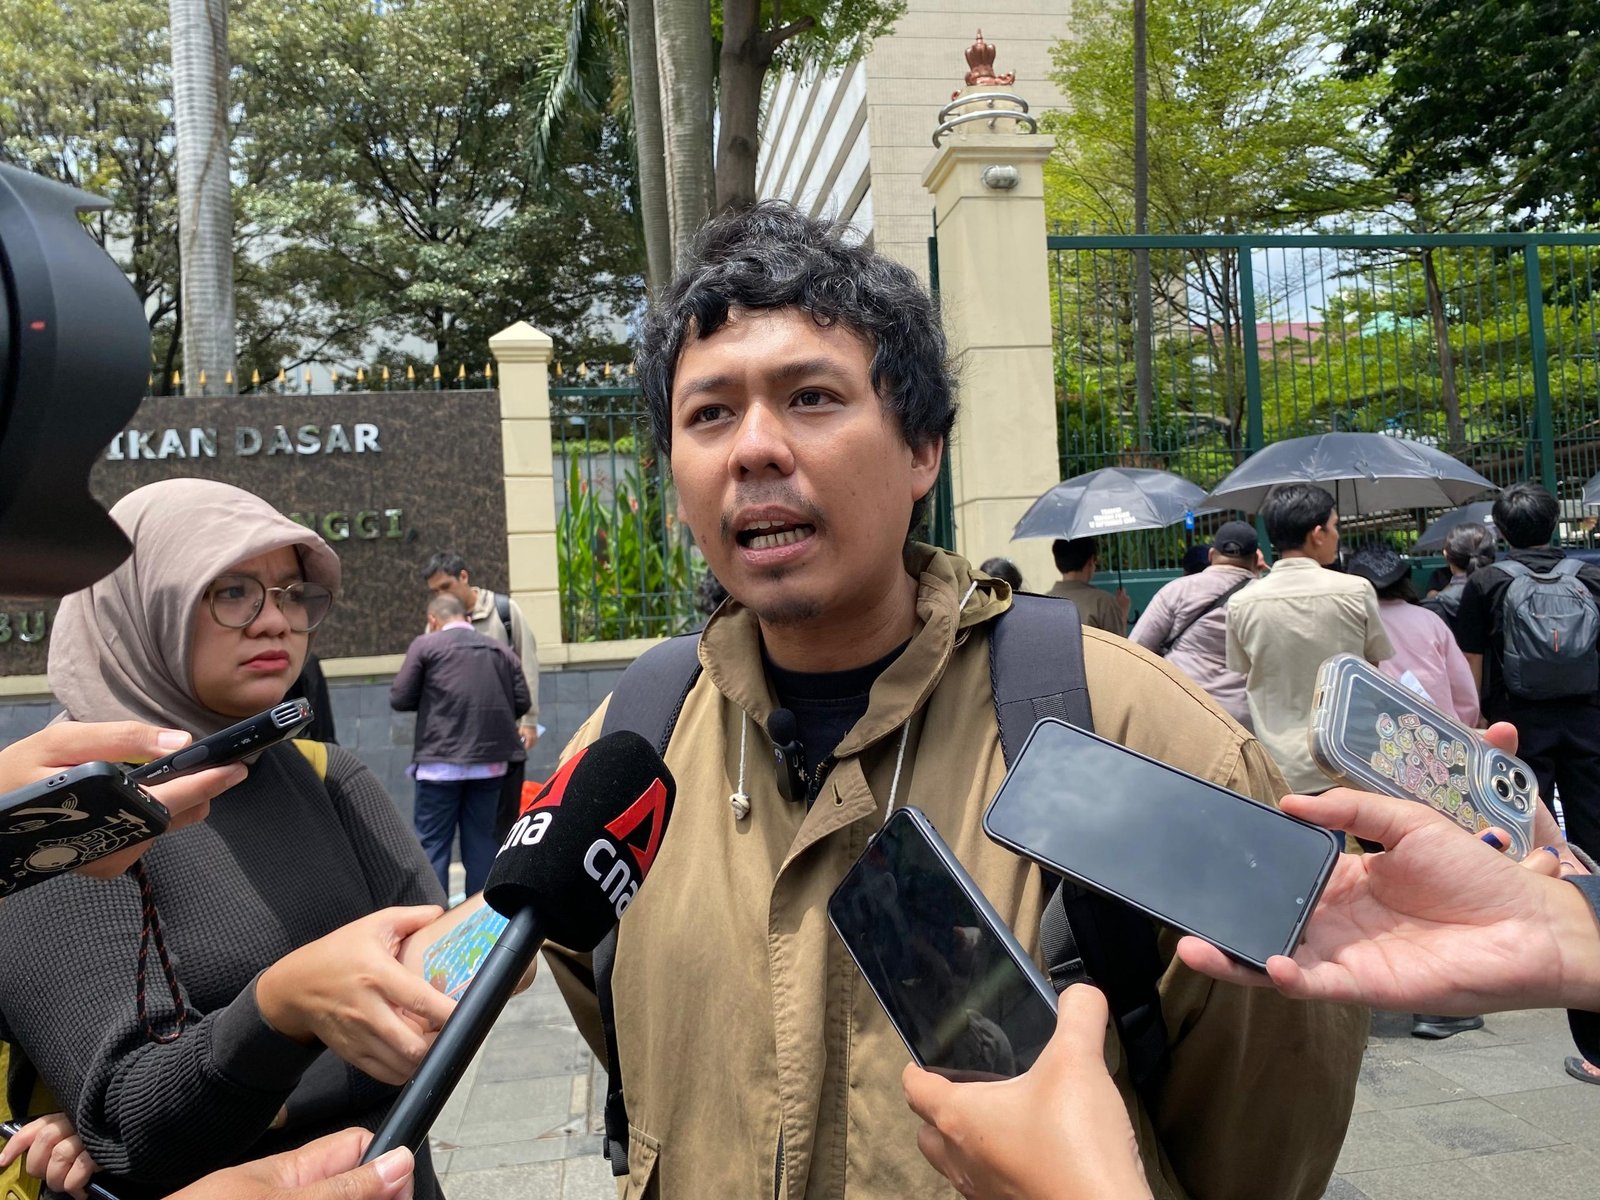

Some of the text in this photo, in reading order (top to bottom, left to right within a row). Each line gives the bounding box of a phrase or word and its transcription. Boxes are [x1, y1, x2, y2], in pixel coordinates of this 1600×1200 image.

[235, 423, 383, 456] DASAR
[495, 811, 553, 859] na
[583, 838, 639, 920] cna
